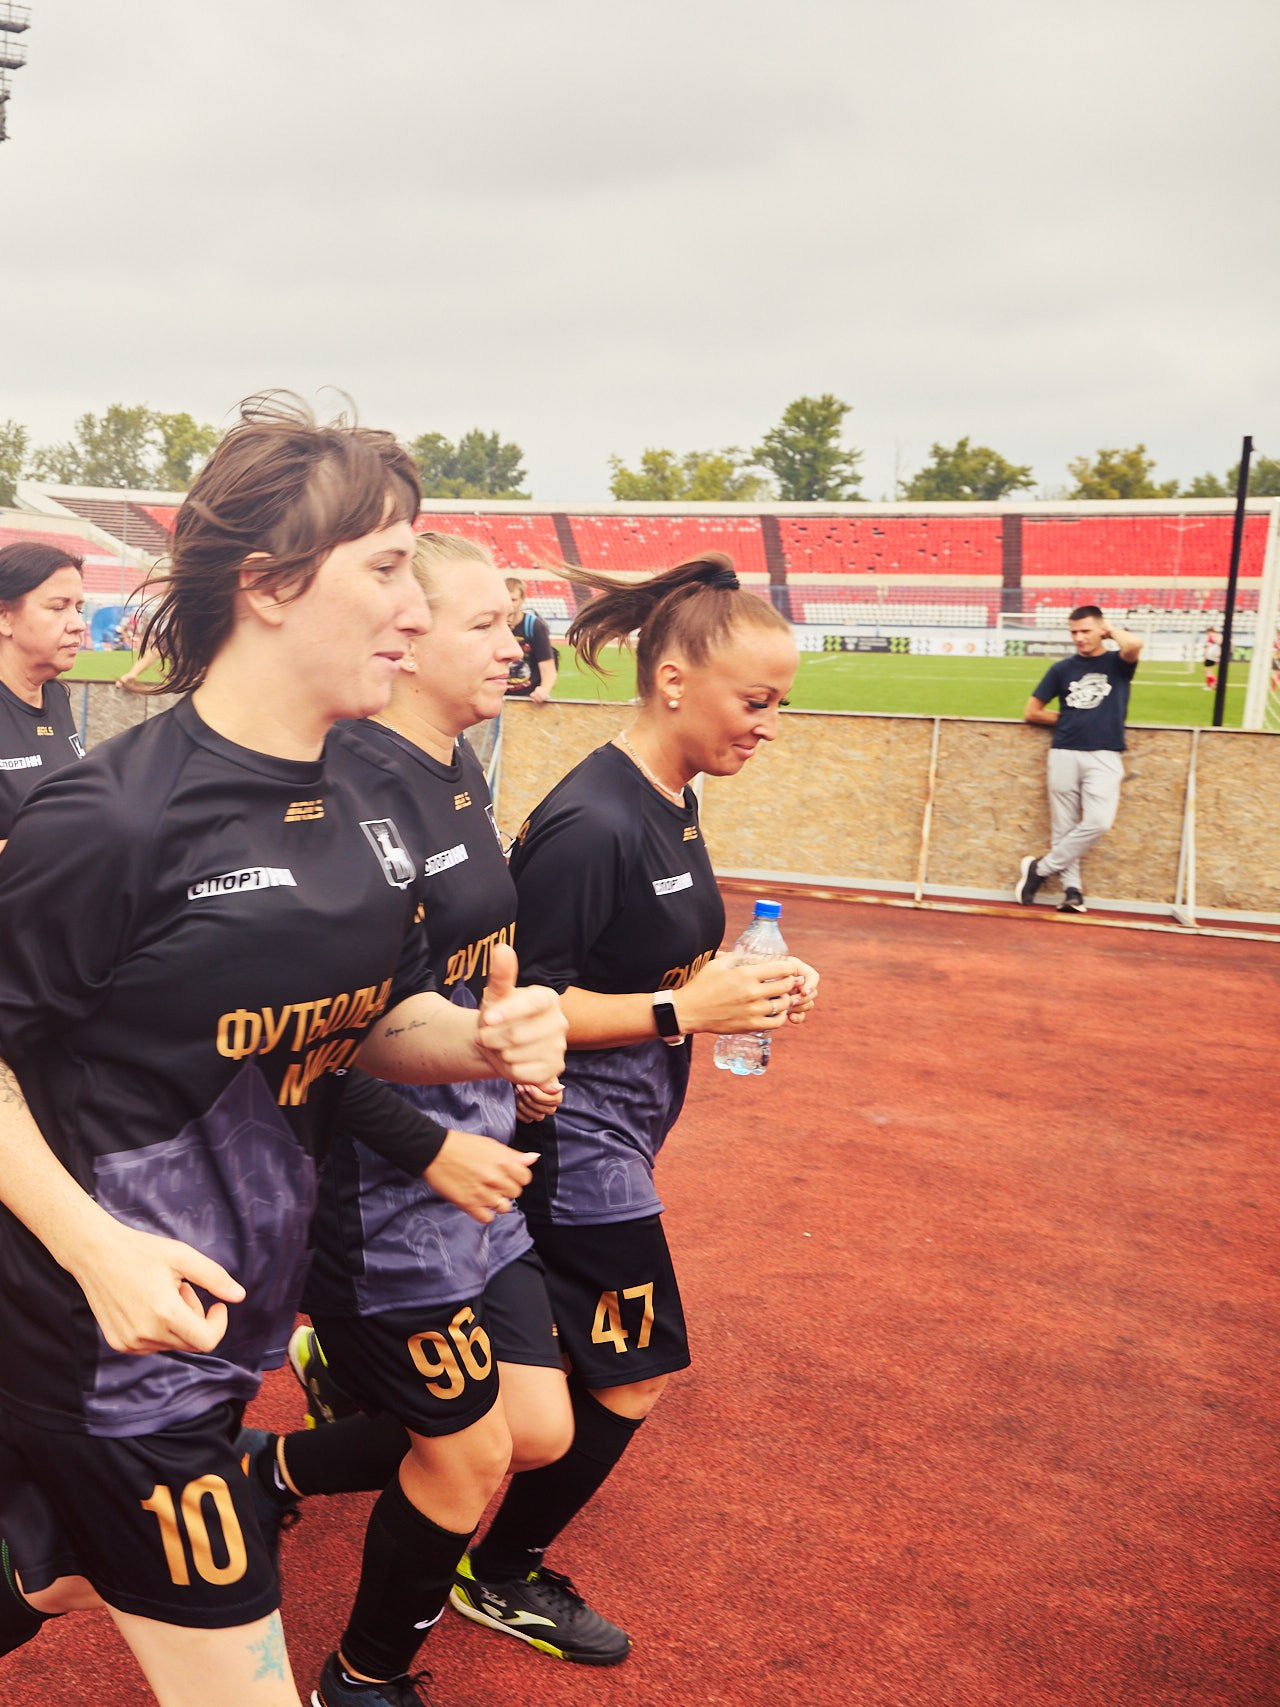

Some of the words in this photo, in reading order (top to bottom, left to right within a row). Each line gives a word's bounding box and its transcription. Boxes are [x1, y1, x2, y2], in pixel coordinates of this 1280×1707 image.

[189, 868, 264, 899] СПОРТ
[407, 1306, 492, 1400] 96
[591, 1282, 655, 1354] 47
[140, 1474, 248, 1586] 10
